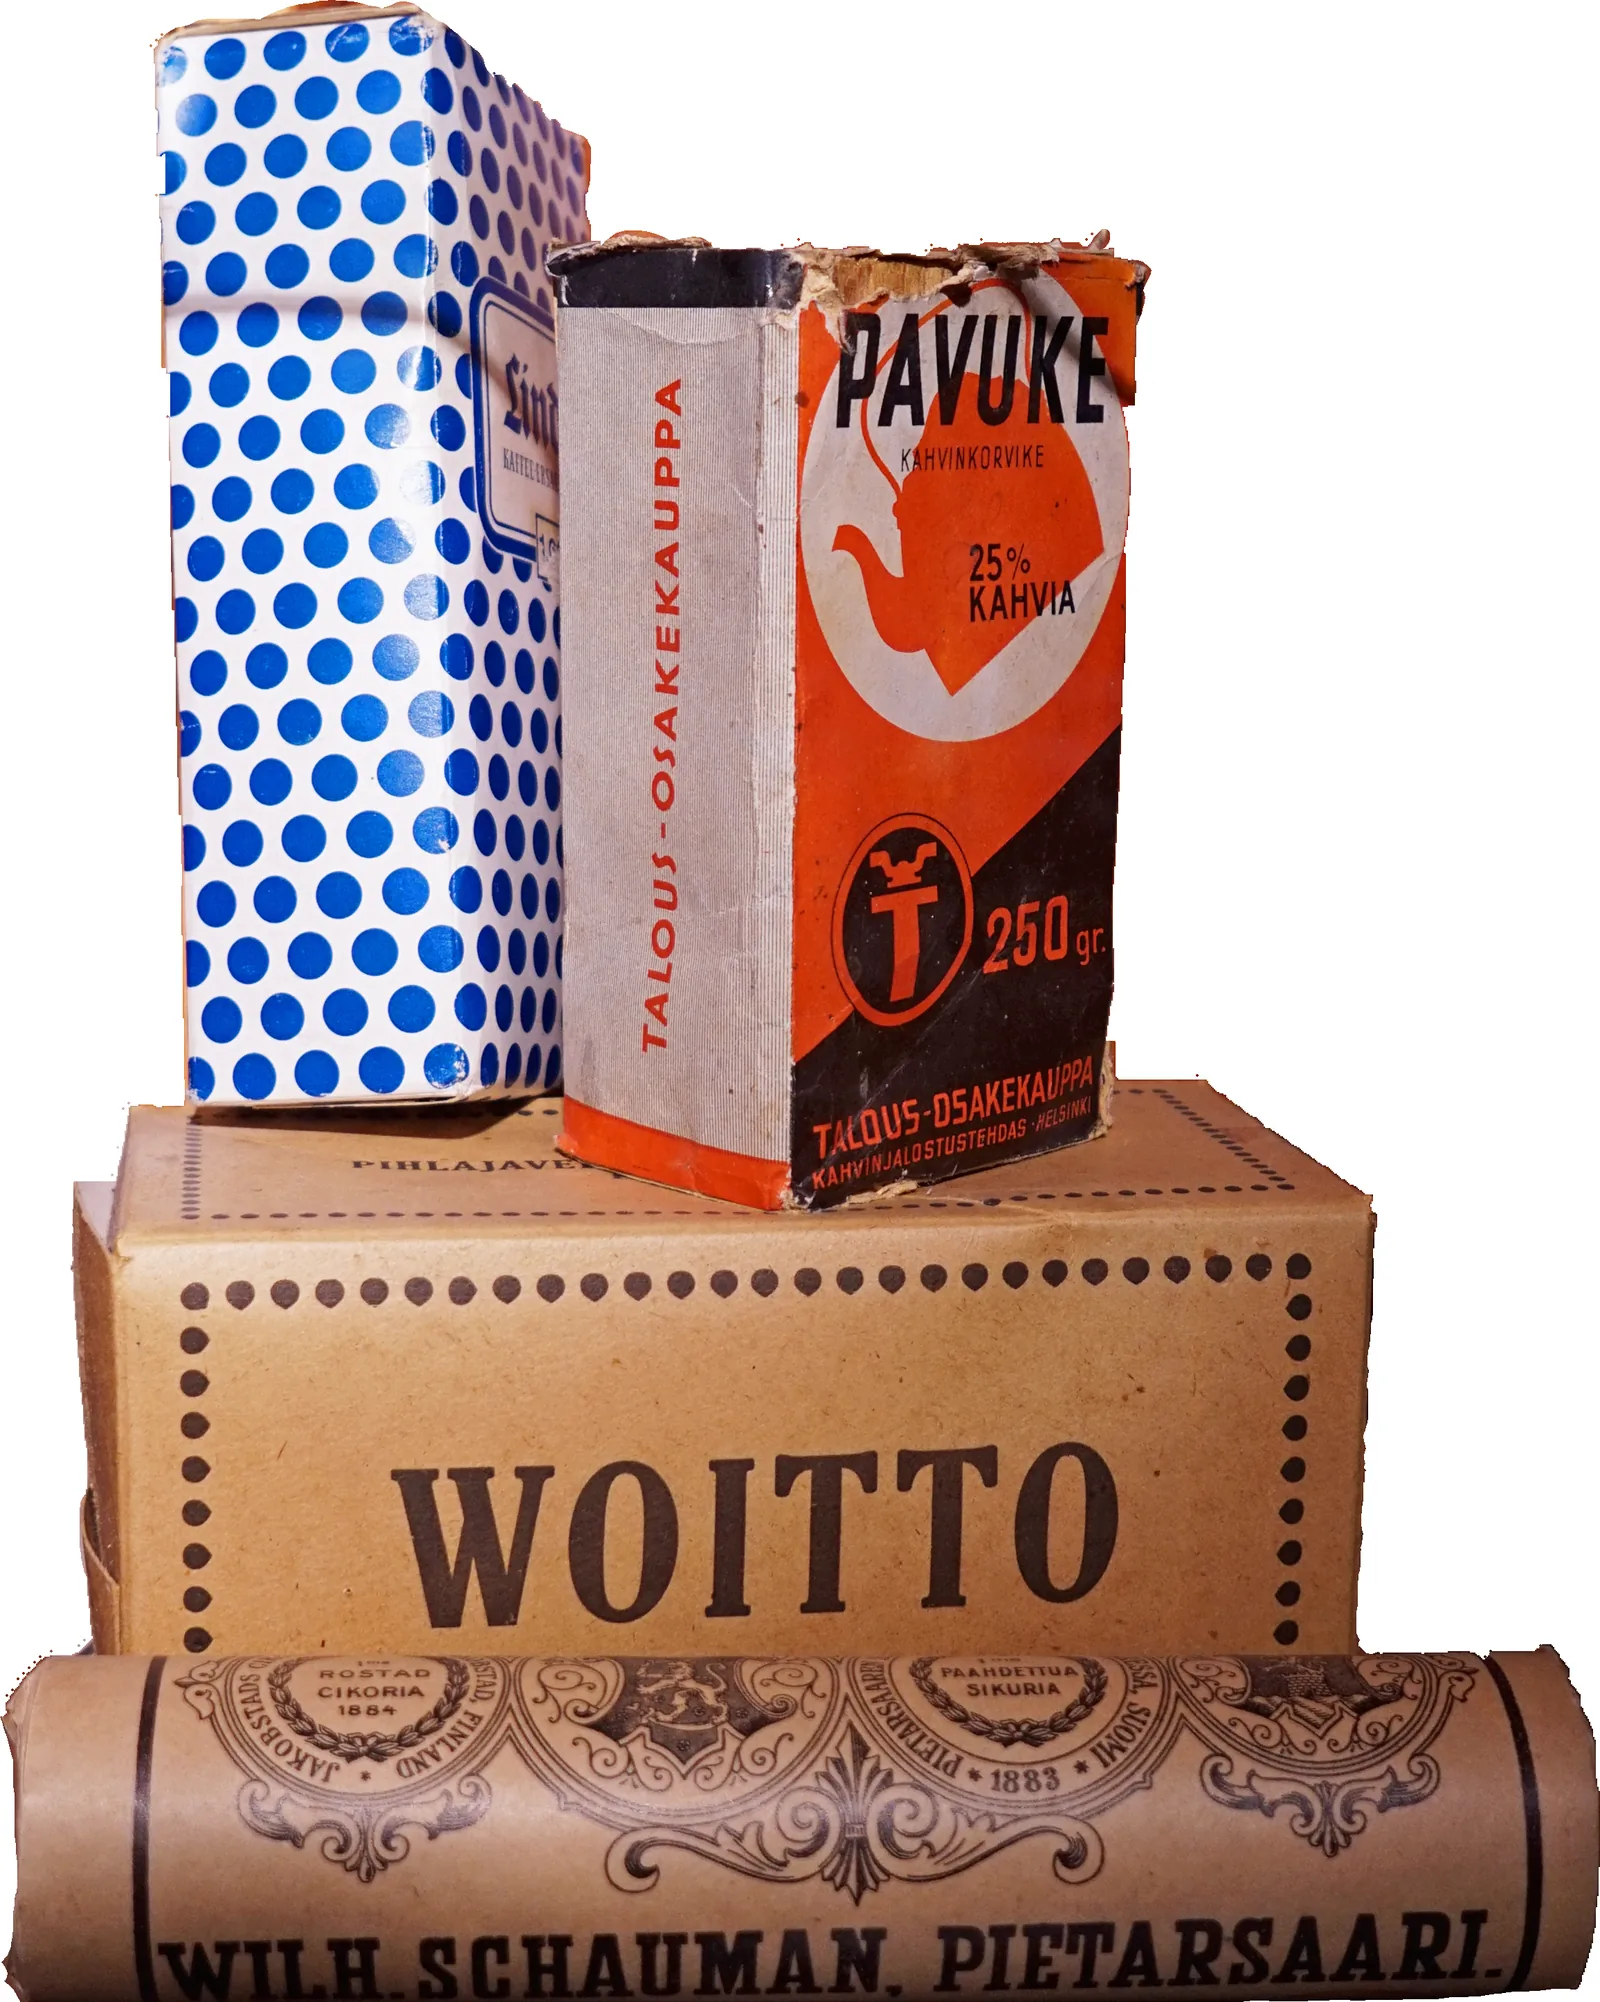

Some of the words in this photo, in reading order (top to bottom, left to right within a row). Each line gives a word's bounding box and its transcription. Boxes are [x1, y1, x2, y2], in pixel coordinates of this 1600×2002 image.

[835, 311, 1109, 428] PAVUKE
[900, 444, 1045, 472] KAHVINKORVIKE
[969, 543, 1031, 582] 25%
[969, 580, 1076, 622] KAHVIA
[982, 895, 1069, 975] 250
[1076, 926, 1106, 966] gr.
[813, 1056, 1094, 1160] TALOUS-OSAKEKAUPPA
[352, 1160, 597, 1172] PIHLAJAVE
[390, 1441, 1120, 1629] WOITTO
[319, 1668, 431, 1679] ROSTAD
[941, 1665, 1079, 1679] PAAHDETTUA
[966, 1682, 1061, 1697] SIKURIA
[317, 1685, 426, 1700] CIKORIA
[338, 1704, 397, 1717] 1884
[239, 1673, 341, 1783] JAKOBSTADS
[395, 1712, 485, 1780] FINLAND
[1089, 1702, 1152, 1769] SUOMI
[990, 1767, 1062, 1794] 1883
[157, 1937, 406, 2001] WILH.
[932, 1909, 1504, 1994] PIETARSAARI.
